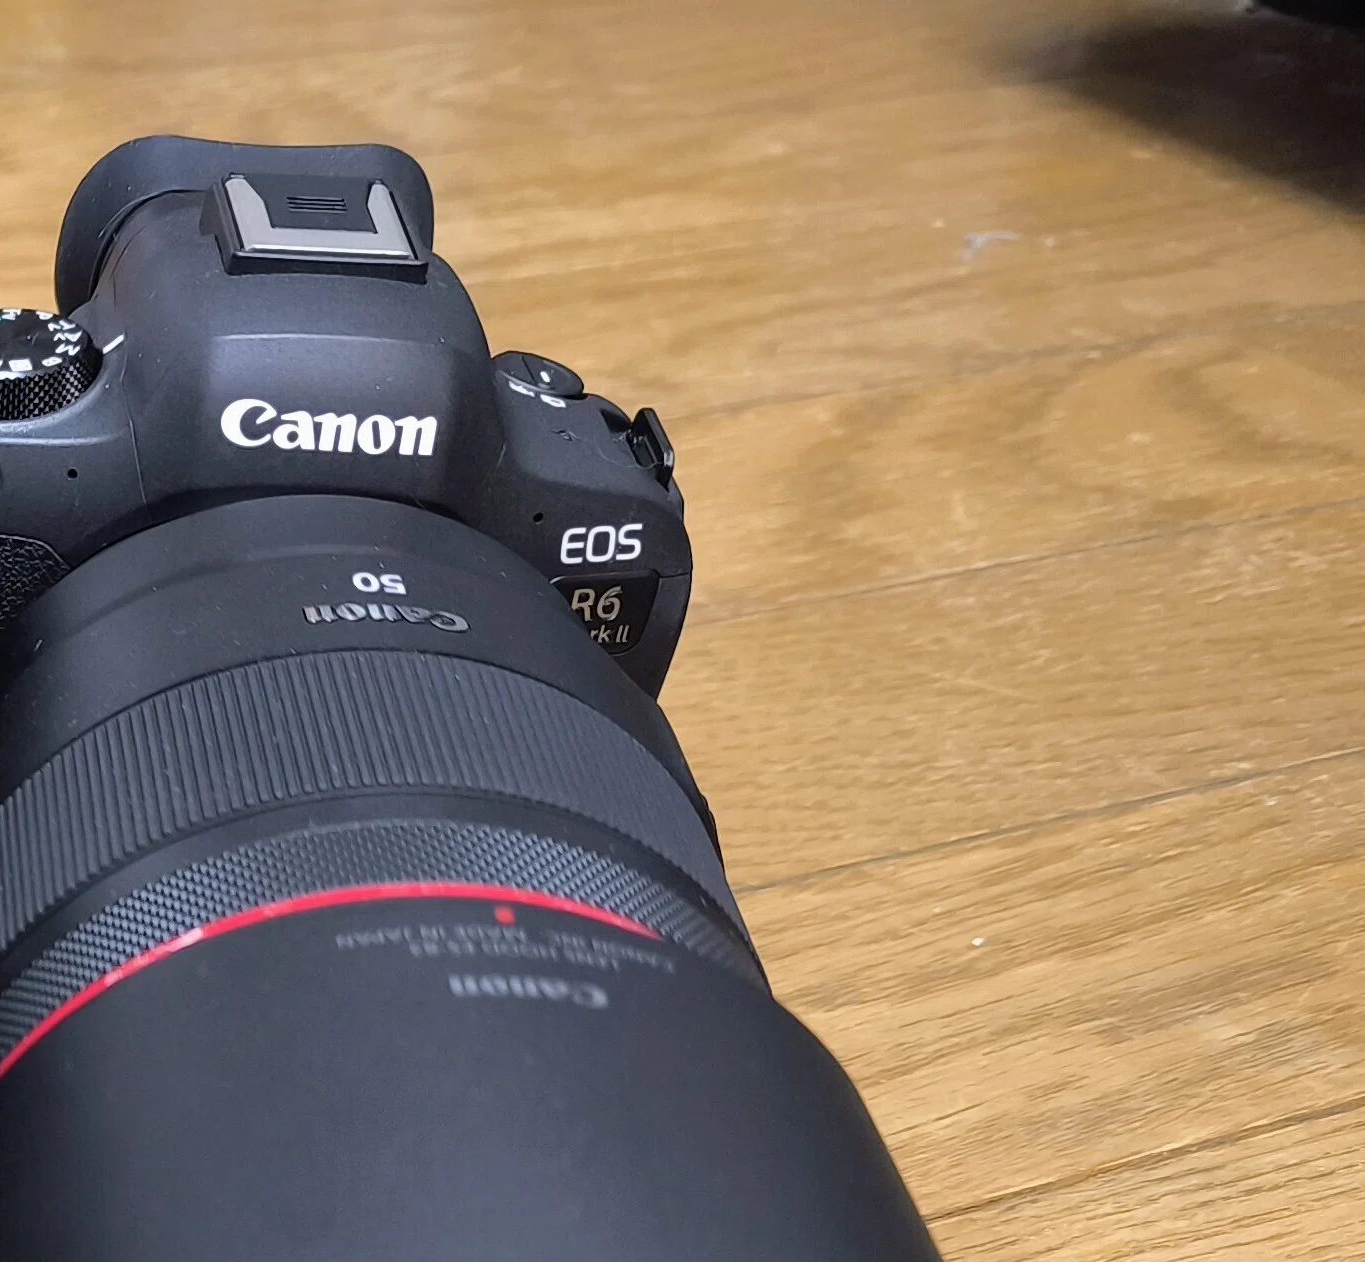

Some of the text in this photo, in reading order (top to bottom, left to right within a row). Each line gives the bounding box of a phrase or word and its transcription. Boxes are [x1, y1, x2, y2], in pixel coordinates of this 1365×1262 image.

[220, 398, 438, 456] Canon
[560, 523, 644, 564] EOS
[352, 570, 407, 596] 50
[302, 602, 469, 633] Canon
[571, 585, 623, 622] R6
[448, 972, 610, 1011] Canon
